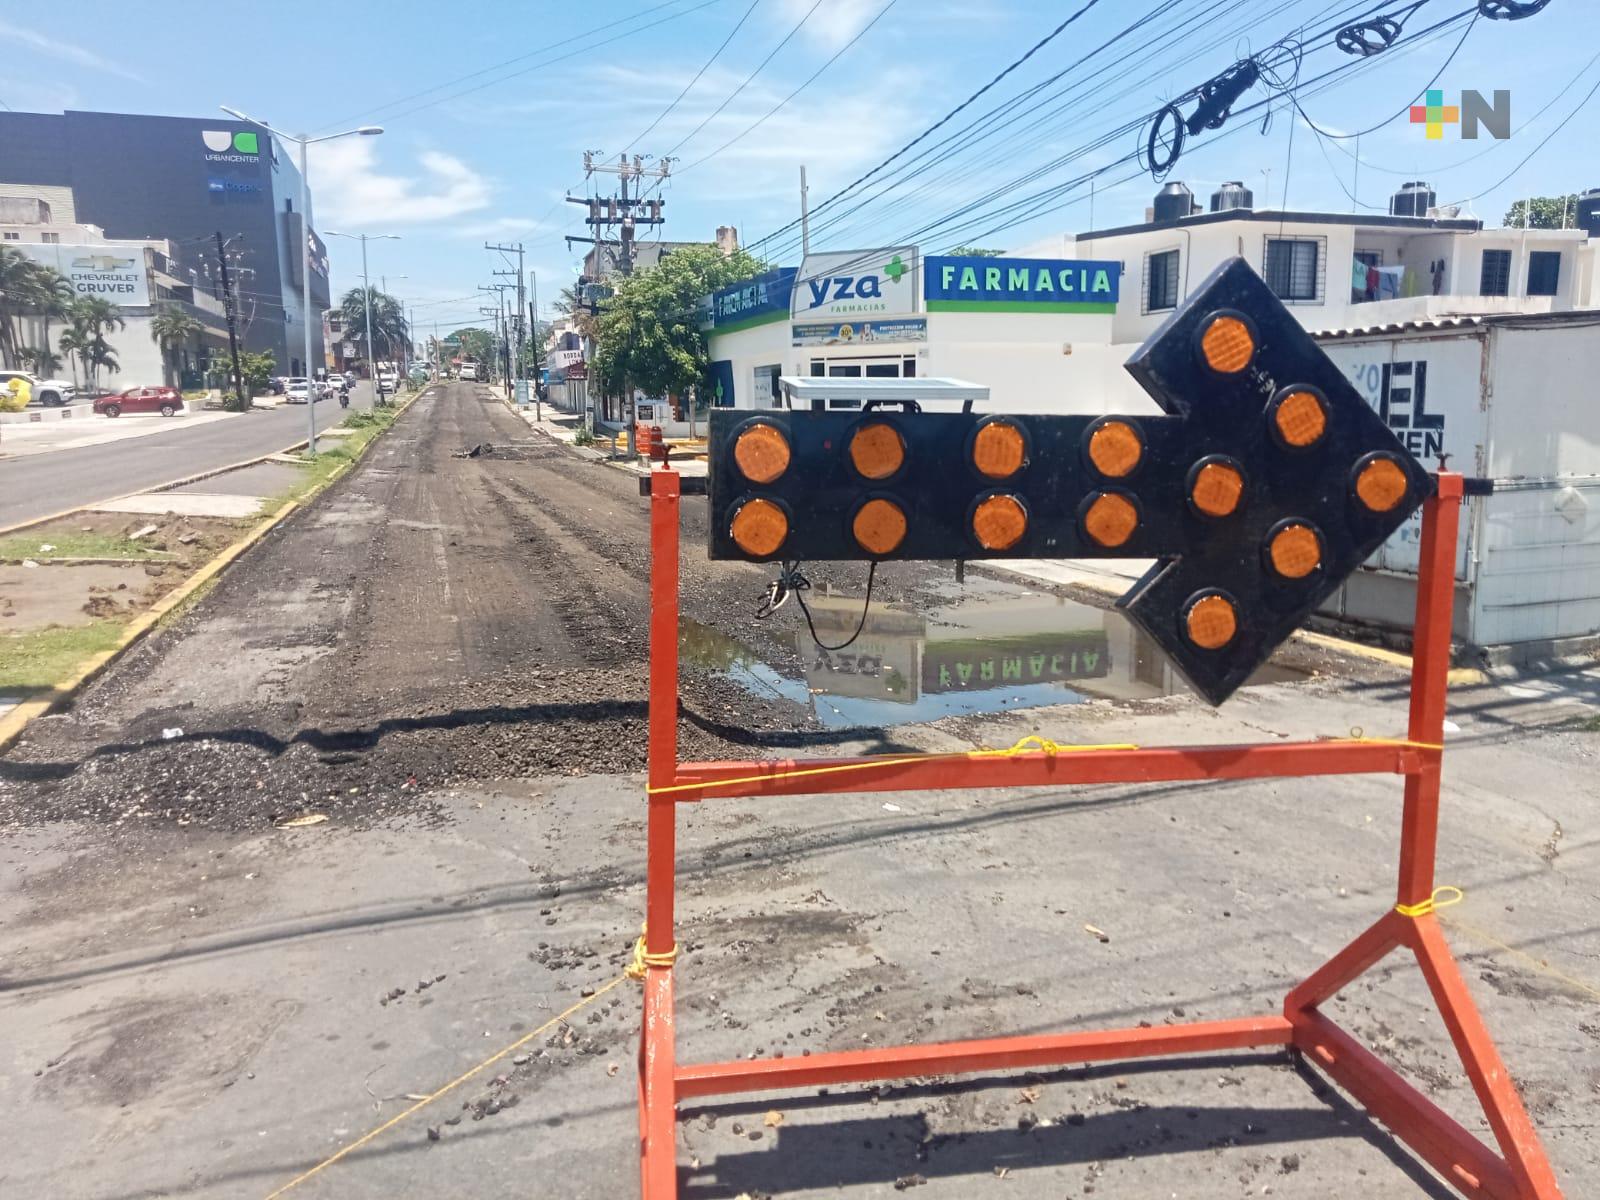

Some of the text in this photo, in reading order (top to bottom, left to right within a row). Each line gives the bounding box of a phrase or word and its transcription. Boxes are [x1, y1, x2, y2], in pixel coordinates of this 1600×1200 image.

[205, 154, 259, 163] URBANCENTER
[71, 274, 139, 282] CHEVROLET
[941, 265, 1112, 294] FARMACIA
[77, 283, 135, 293] GRUVER
[808, 275, 882, 308] yza
[830, 303, 887, 313] FARMACIAS
[1379, 361, 1445, 429] EL
